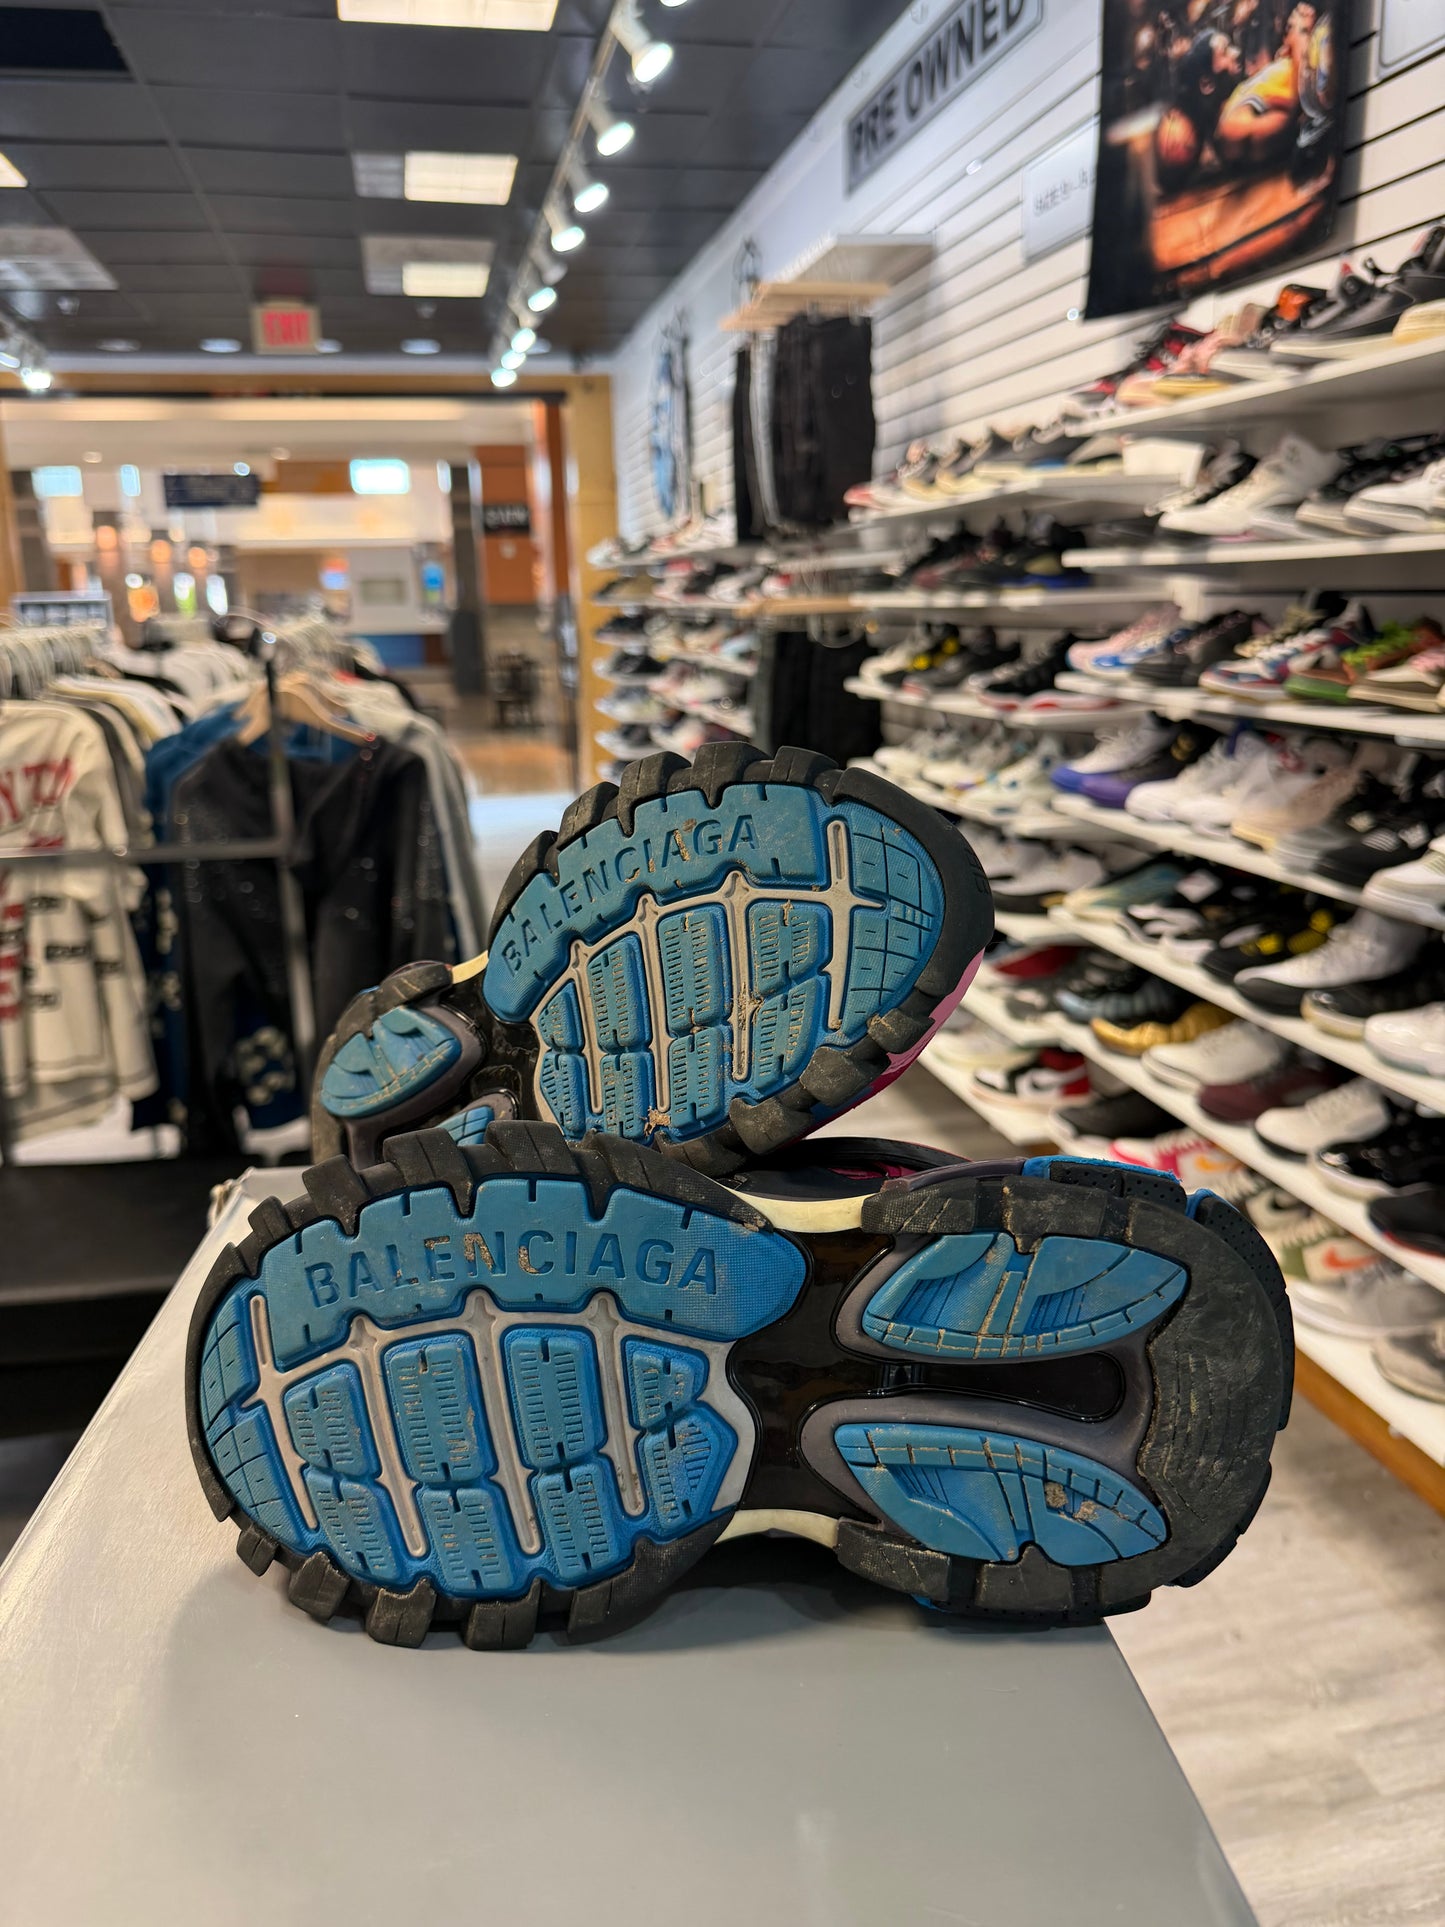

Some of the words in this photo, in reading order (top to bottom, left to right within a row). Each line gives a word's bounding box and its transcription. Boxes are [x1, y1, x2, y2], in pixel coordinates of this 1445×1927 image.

[852, 86, 897, 166] PRE
[905, 0, 1023, 121] OWNED
[501, 813, 760, 977] BALENCIAGA
[304, 1229, 718, 1309] BALENCIAGA
